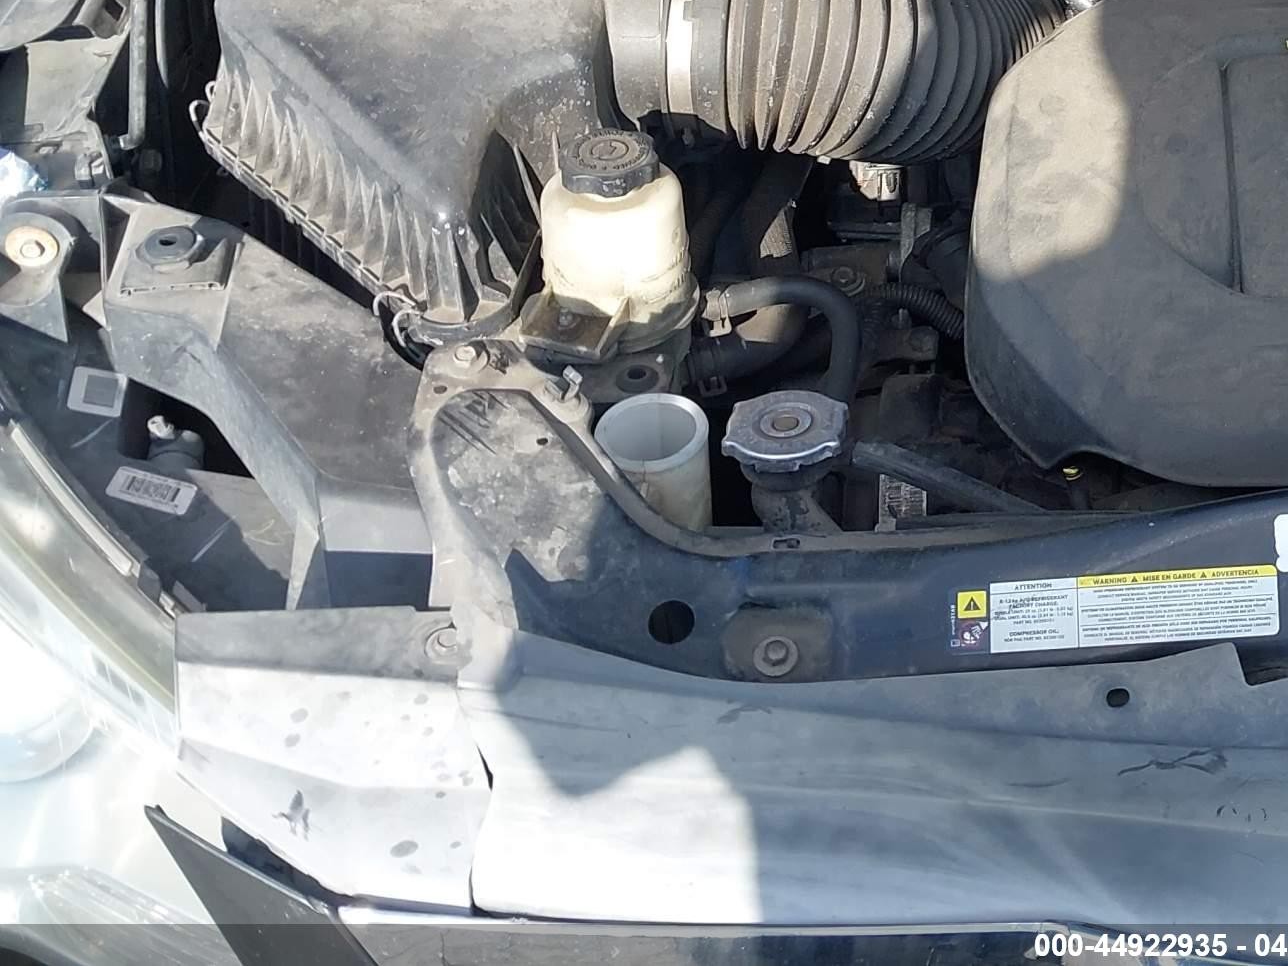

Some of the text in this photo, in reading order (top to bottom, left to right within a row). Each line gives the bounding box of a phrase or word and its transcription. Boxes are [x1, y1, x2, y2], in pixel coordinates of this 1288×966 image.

[1092, 577, 1127, 586] WARNING
[1142, 574, 1161, 582] MISE
[1172, 572, 1197, 580] GARDE
[1211, 569, 1260, 577] ADVERTENCIA
[1014, 582, 1053, 591] ATTENTION
